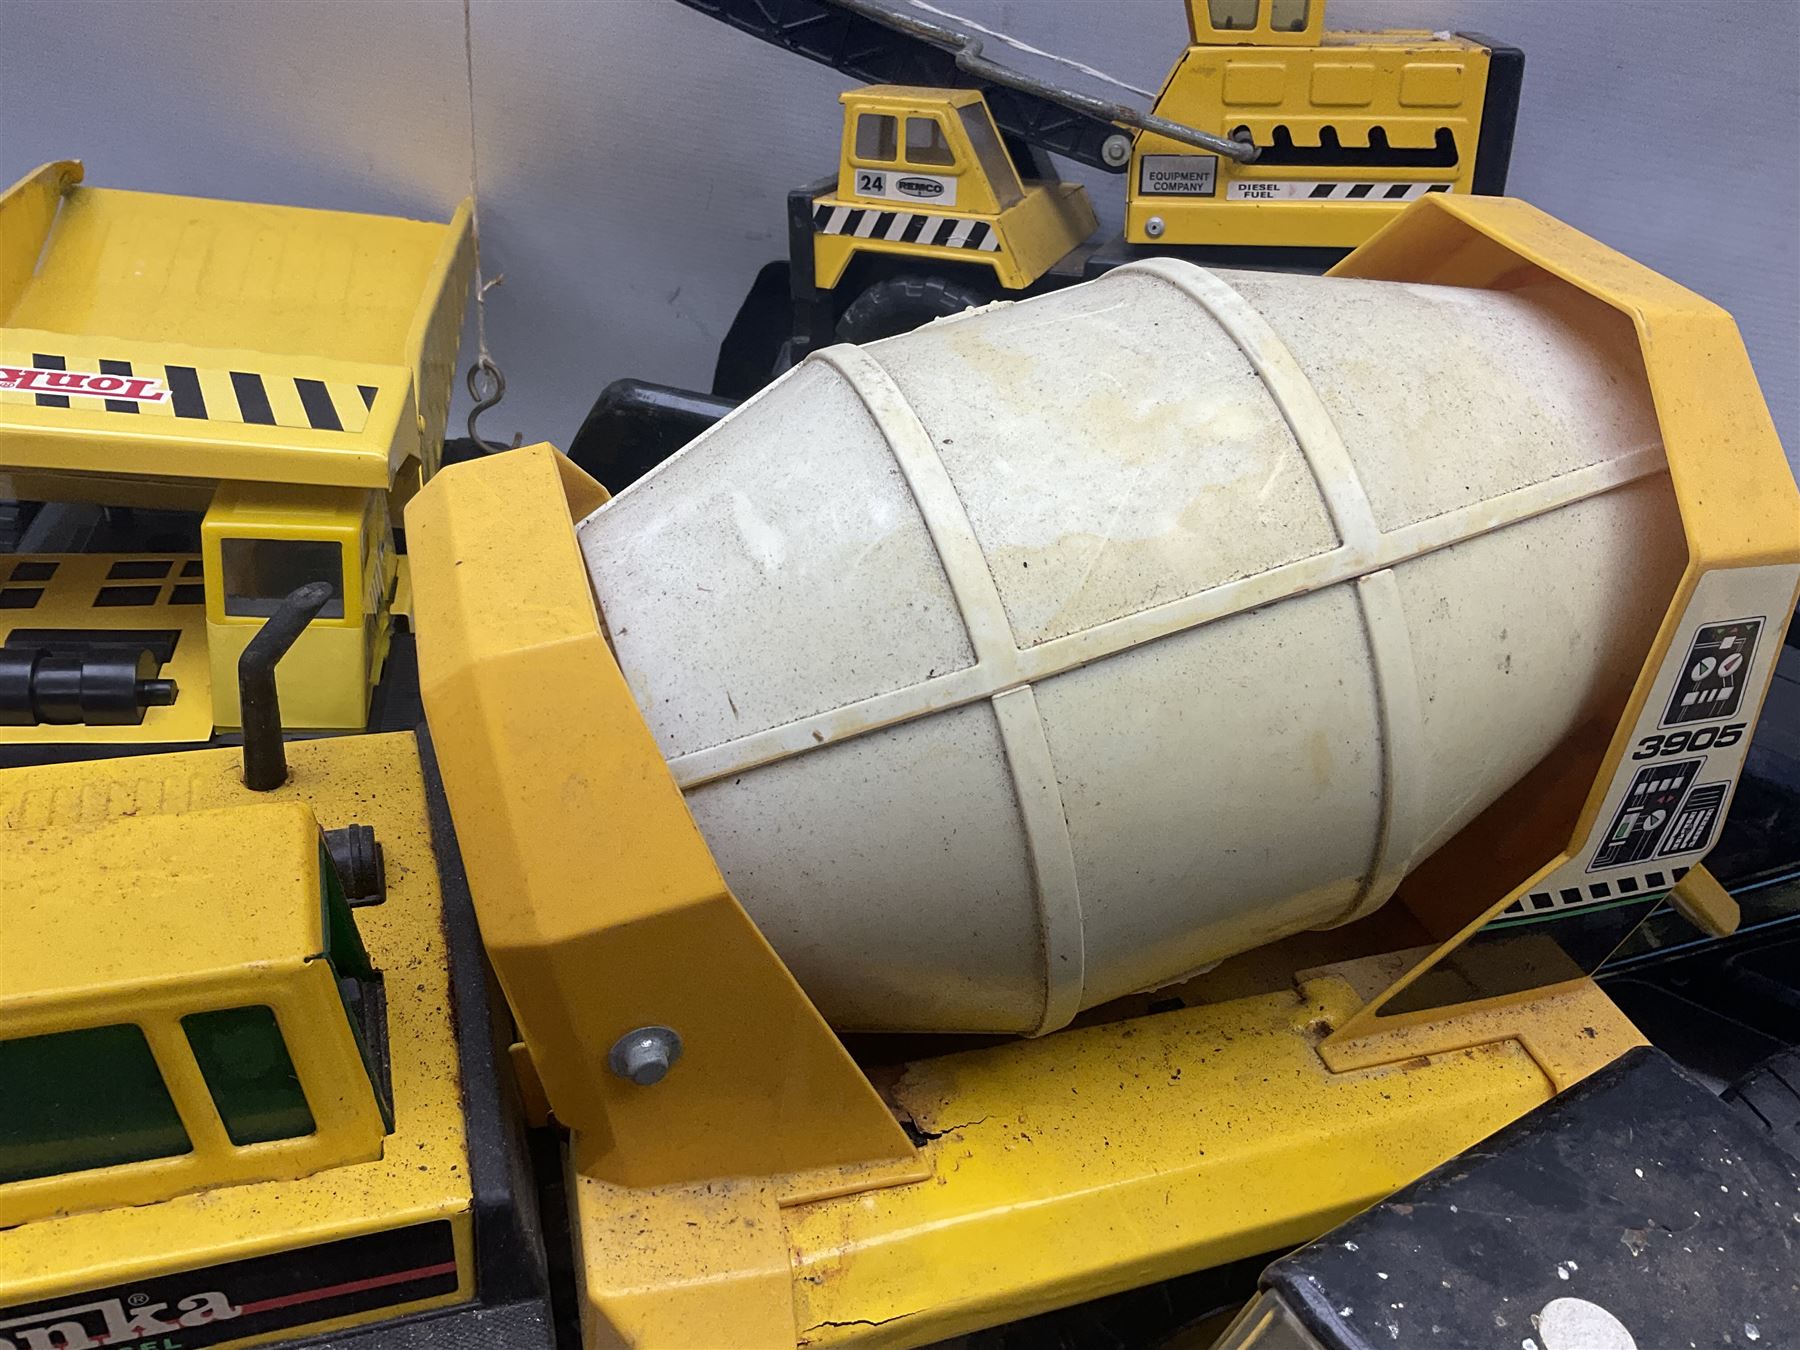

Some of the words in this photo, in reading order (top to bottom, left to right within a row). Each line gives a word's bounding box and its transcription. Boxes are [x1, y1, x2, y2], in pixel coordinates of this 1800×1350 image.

[1149, 172, 1211, 182] EQUIPMENT
[860, 175, 883, 192] 24
[899, 181, 942, 193] REMCO
[1153, 182, 1204, 191] COMPANY
[1632, 723, 1747, 760] 3905
